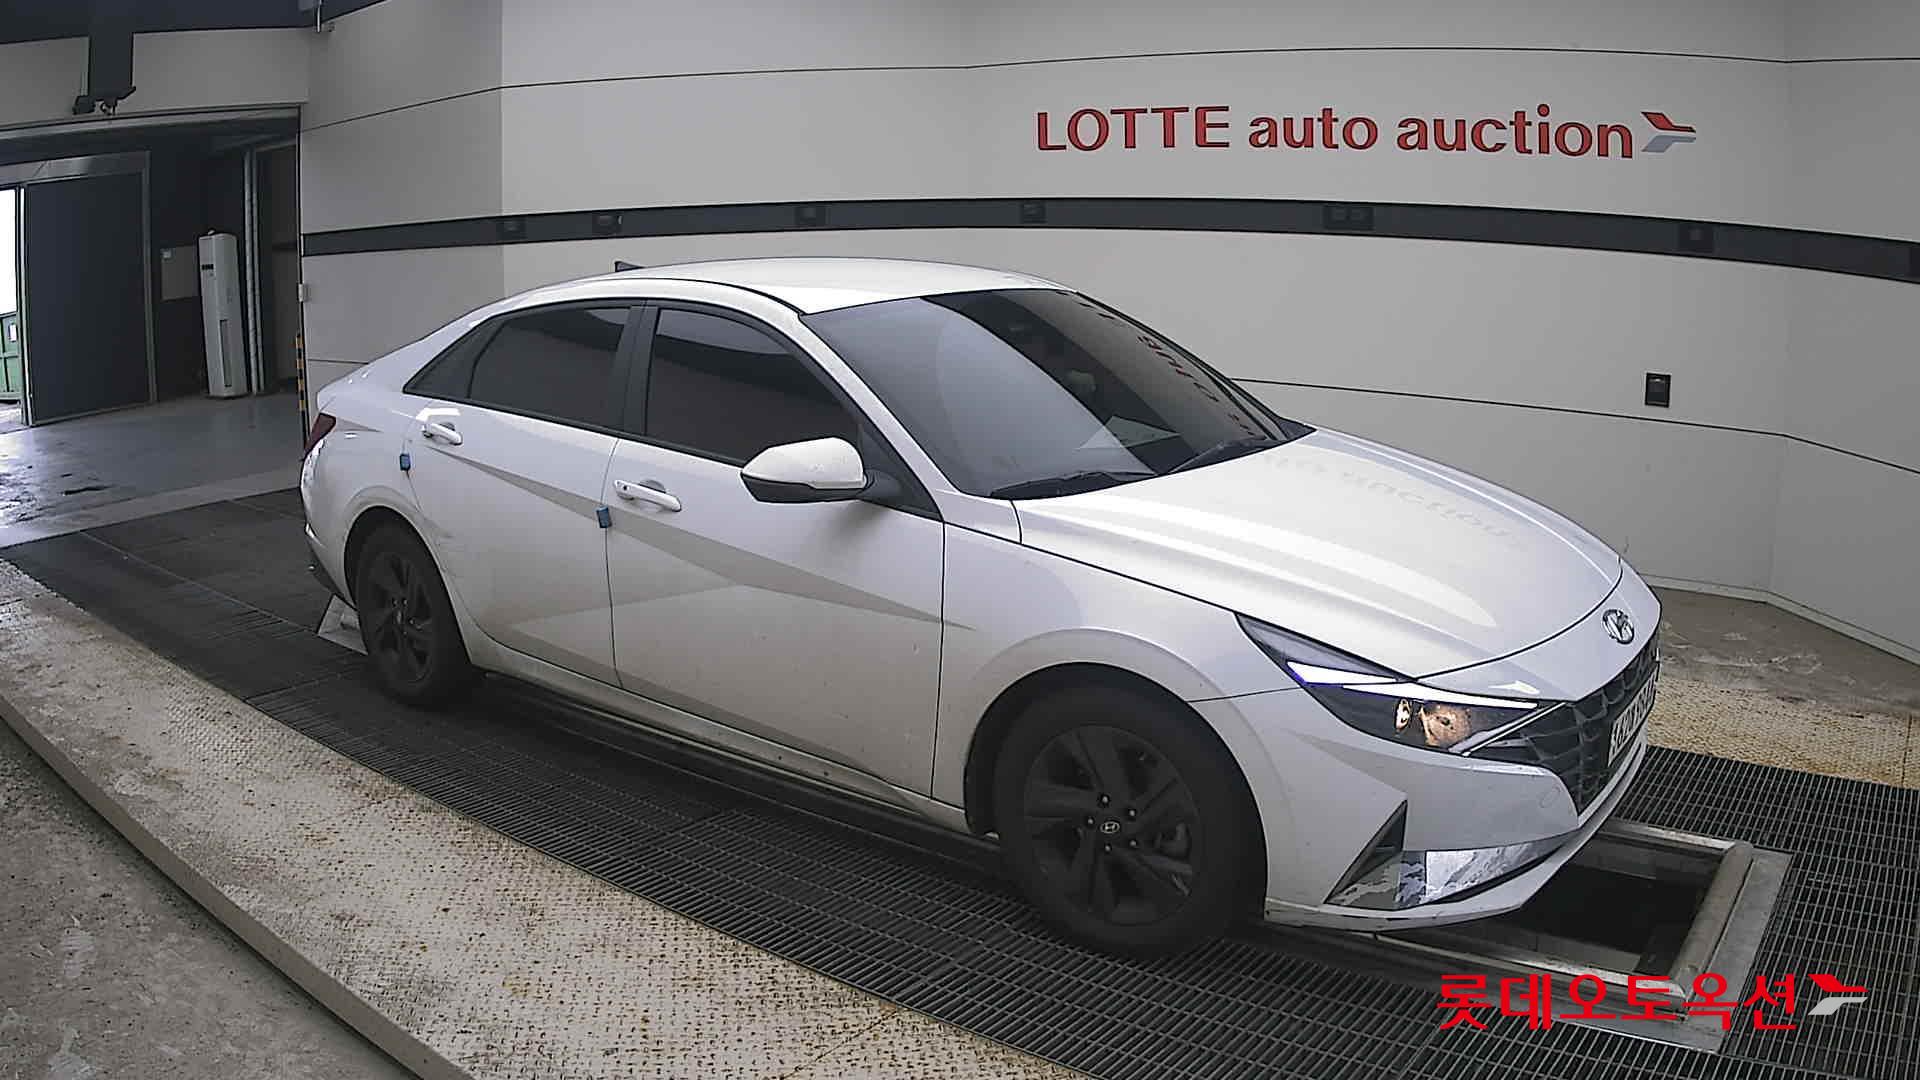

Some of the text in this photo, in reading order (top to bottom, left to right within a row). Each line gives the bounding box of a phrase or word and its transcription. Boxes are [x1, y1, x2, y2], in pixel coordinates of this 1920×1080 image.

[1036, 103, 1633, 158] LOTTE auto auction
